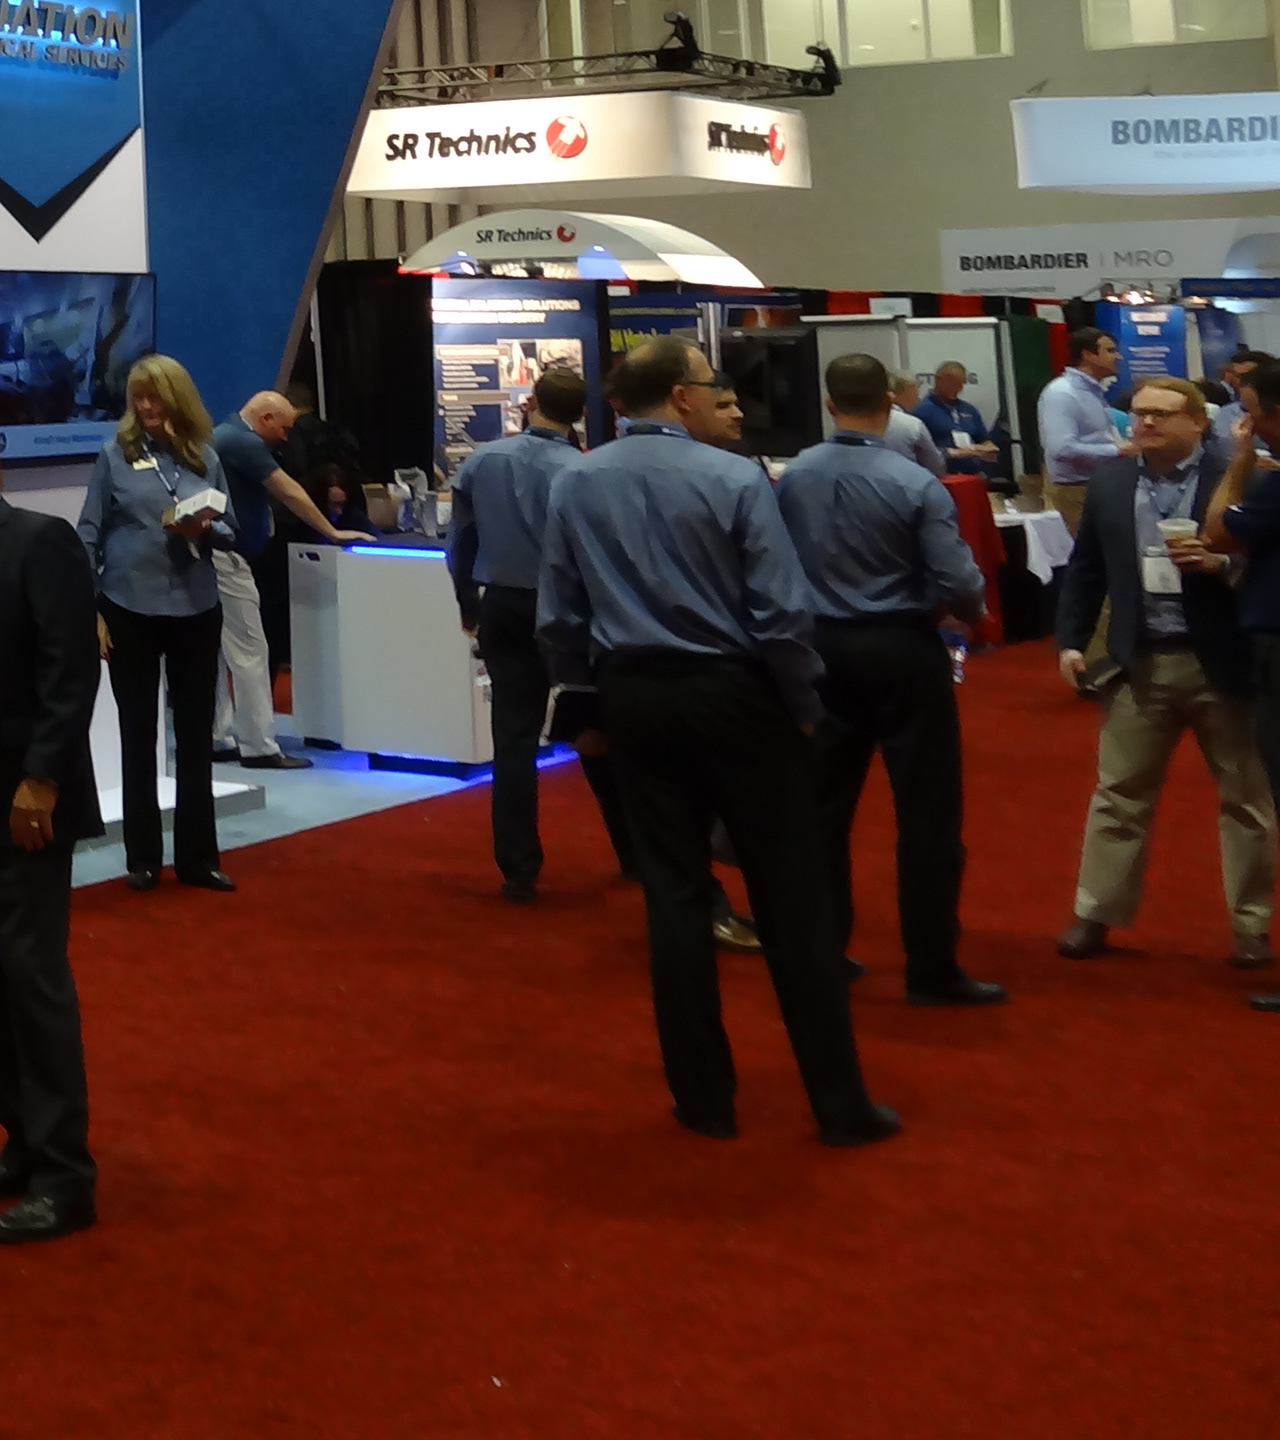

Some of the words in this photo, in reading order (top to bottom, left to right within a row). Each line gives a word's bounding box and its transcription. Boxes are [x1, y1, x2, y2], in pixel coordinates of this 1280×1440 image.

[385, 133, 419, 161] SR
[425, 125, 536, 158] Technics
[476, 228, 493, 243] SR
[496, 226, 552, 242] Technics
[959, 252, 1089, 272] BOMBARDIER
[1113, 249, 1174, 267] MRO
